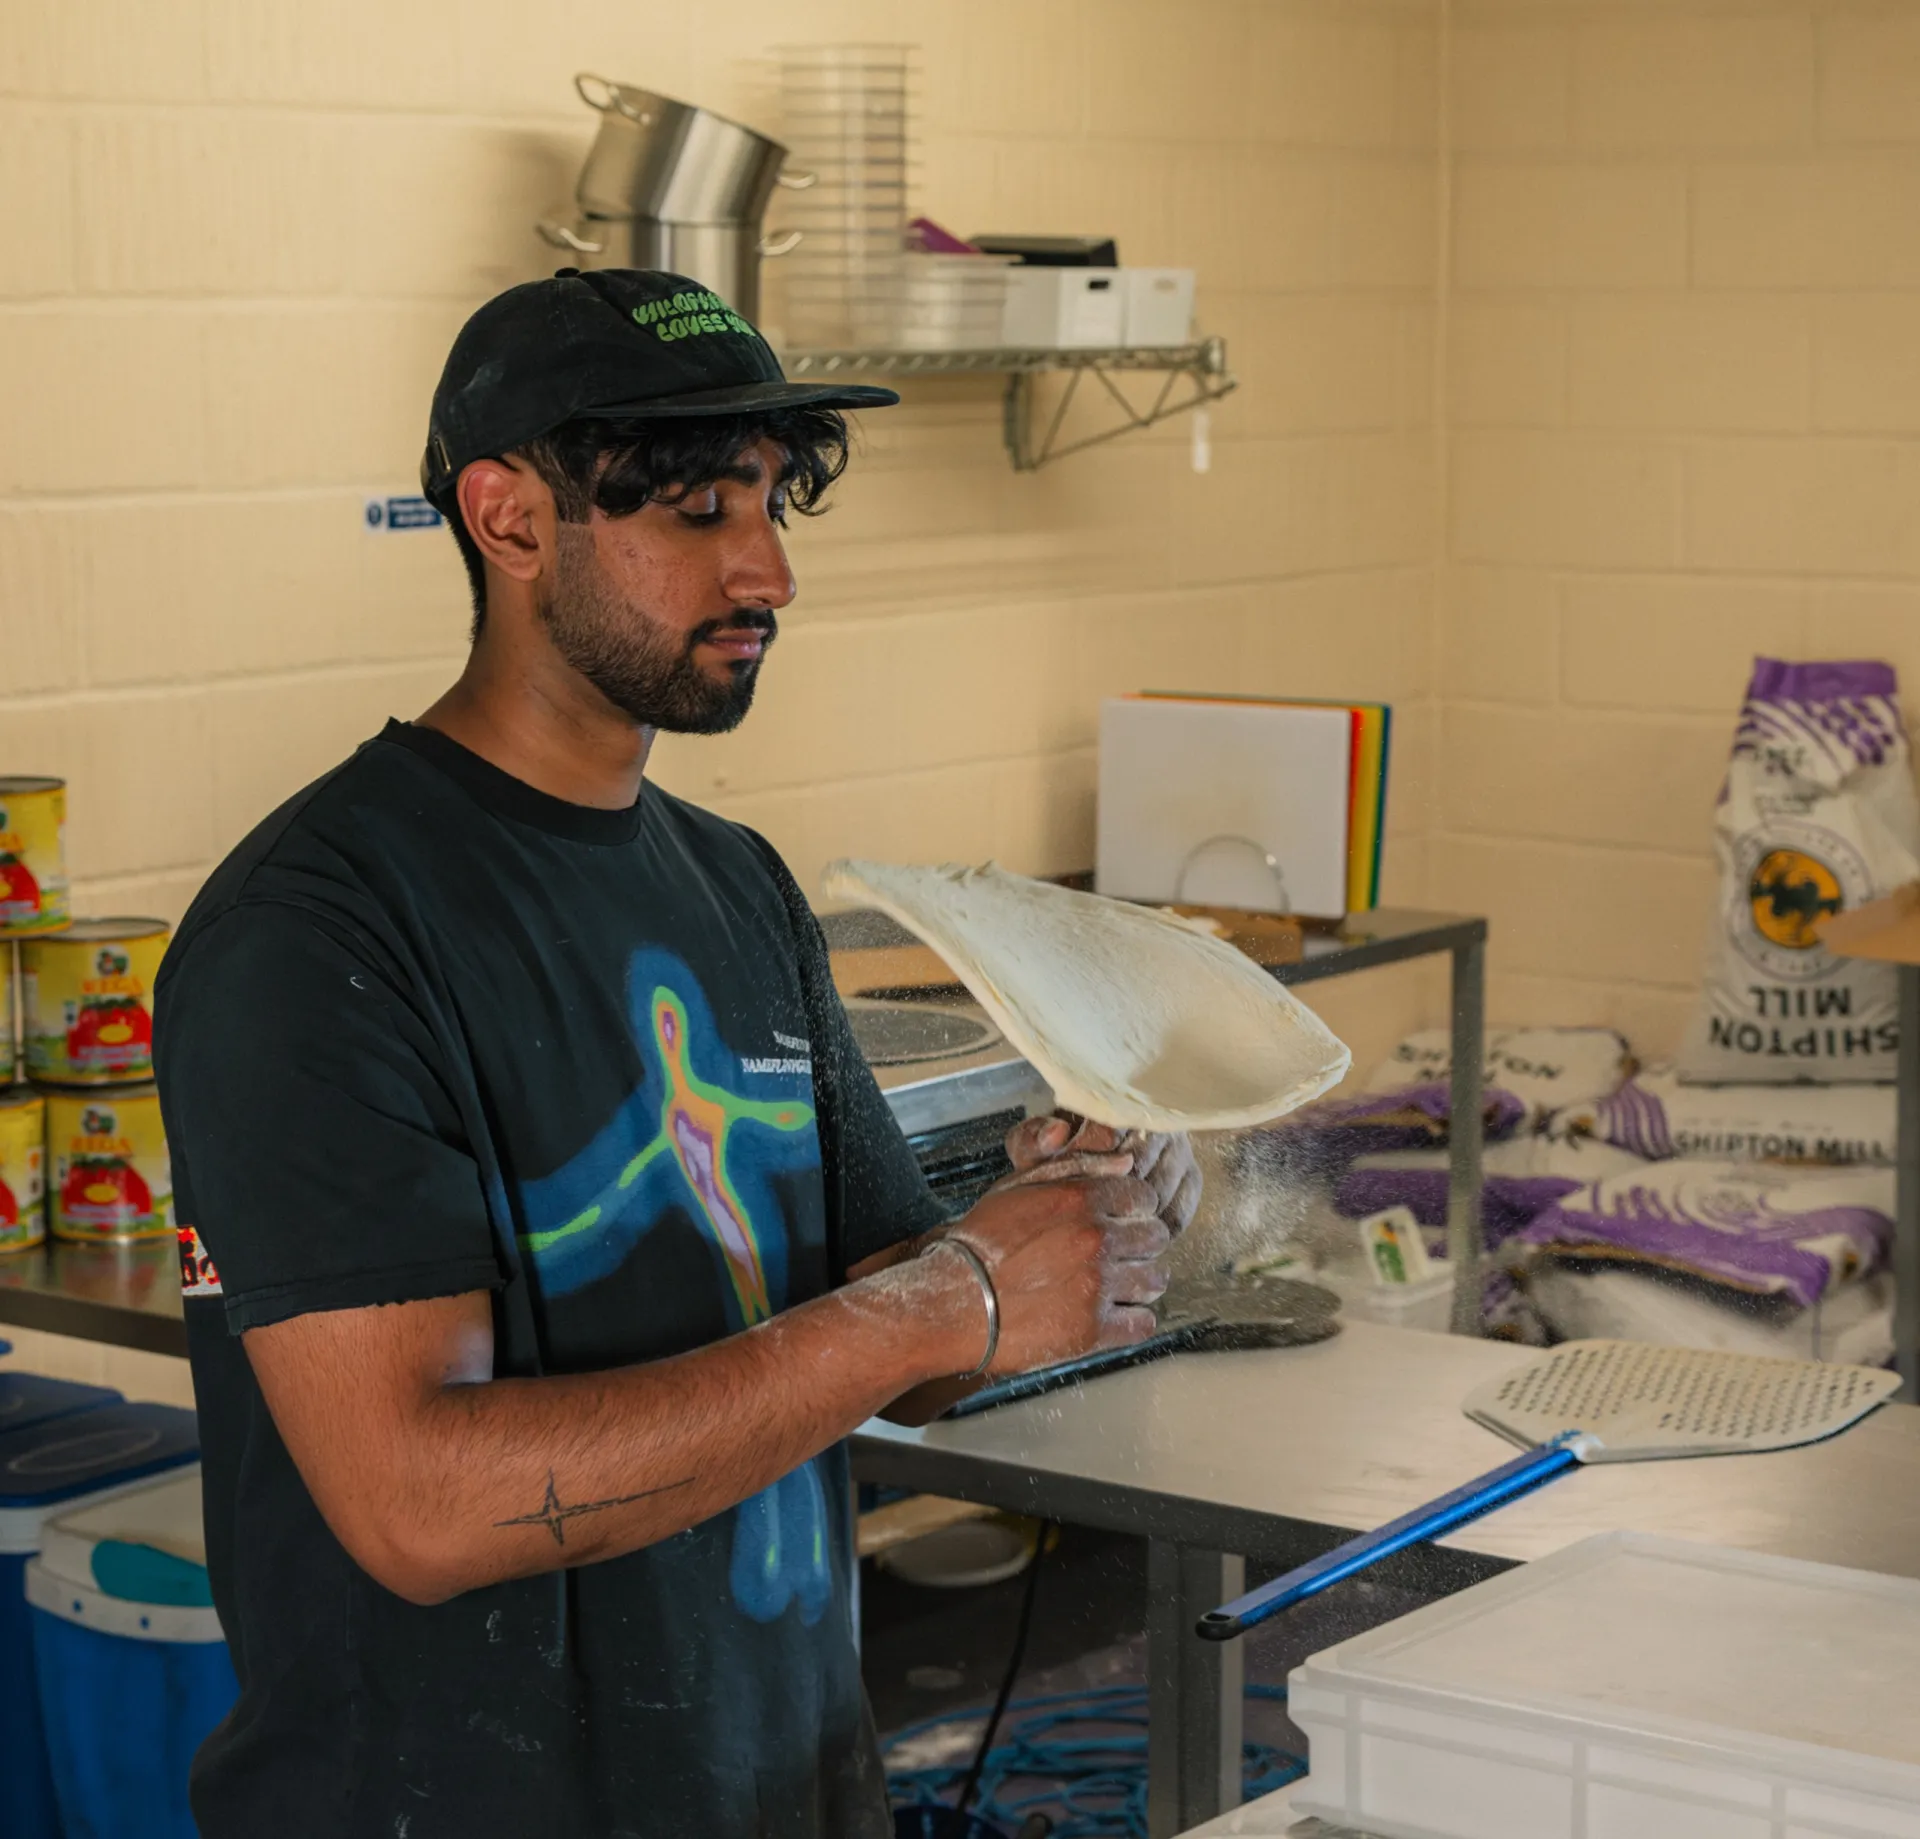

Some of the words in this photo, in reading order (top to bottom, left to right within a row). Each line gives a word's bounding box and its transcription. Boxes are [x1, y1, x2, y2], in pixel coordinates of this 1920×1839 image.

[656, 312, 729, 342] LOVES
[1749, 986, 1850, 1019] MILL
[1708, 1017, 1900, 1058] SHIPTON
[1672, 1130, 1806, 1157] SHIPTON
[1814, 1137, 1894, 1166] MILL
